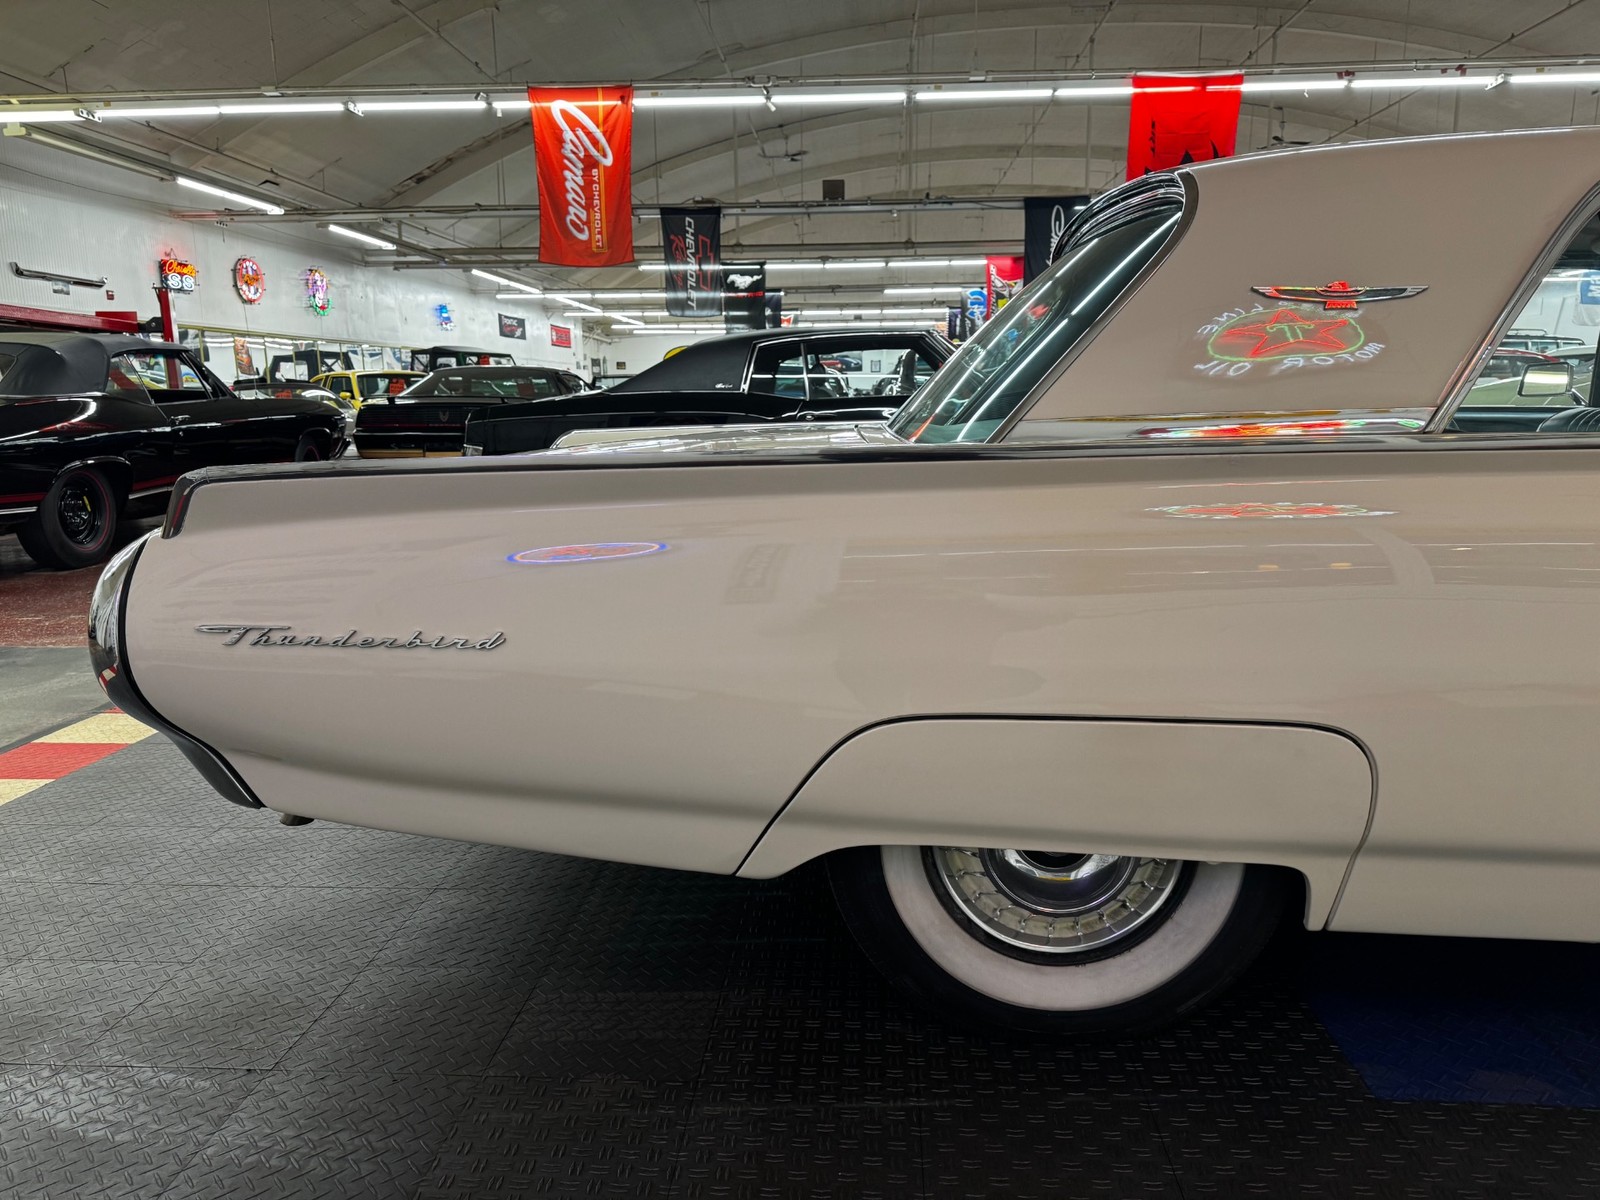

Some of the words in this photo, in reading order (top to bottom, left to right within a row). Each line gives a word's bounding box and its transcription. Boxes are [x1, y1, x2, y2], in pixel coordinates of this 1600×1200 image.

[551, 99, 613, 241] Camaro
[591, 168, 598, 183] BY
[593, 183, 603, 248] CHEVROLET
[168, 273, 195, 291] SS
[685, 216, 697, 311] CHEVROLET
[195, 624, 506, 651] Thunderbird
